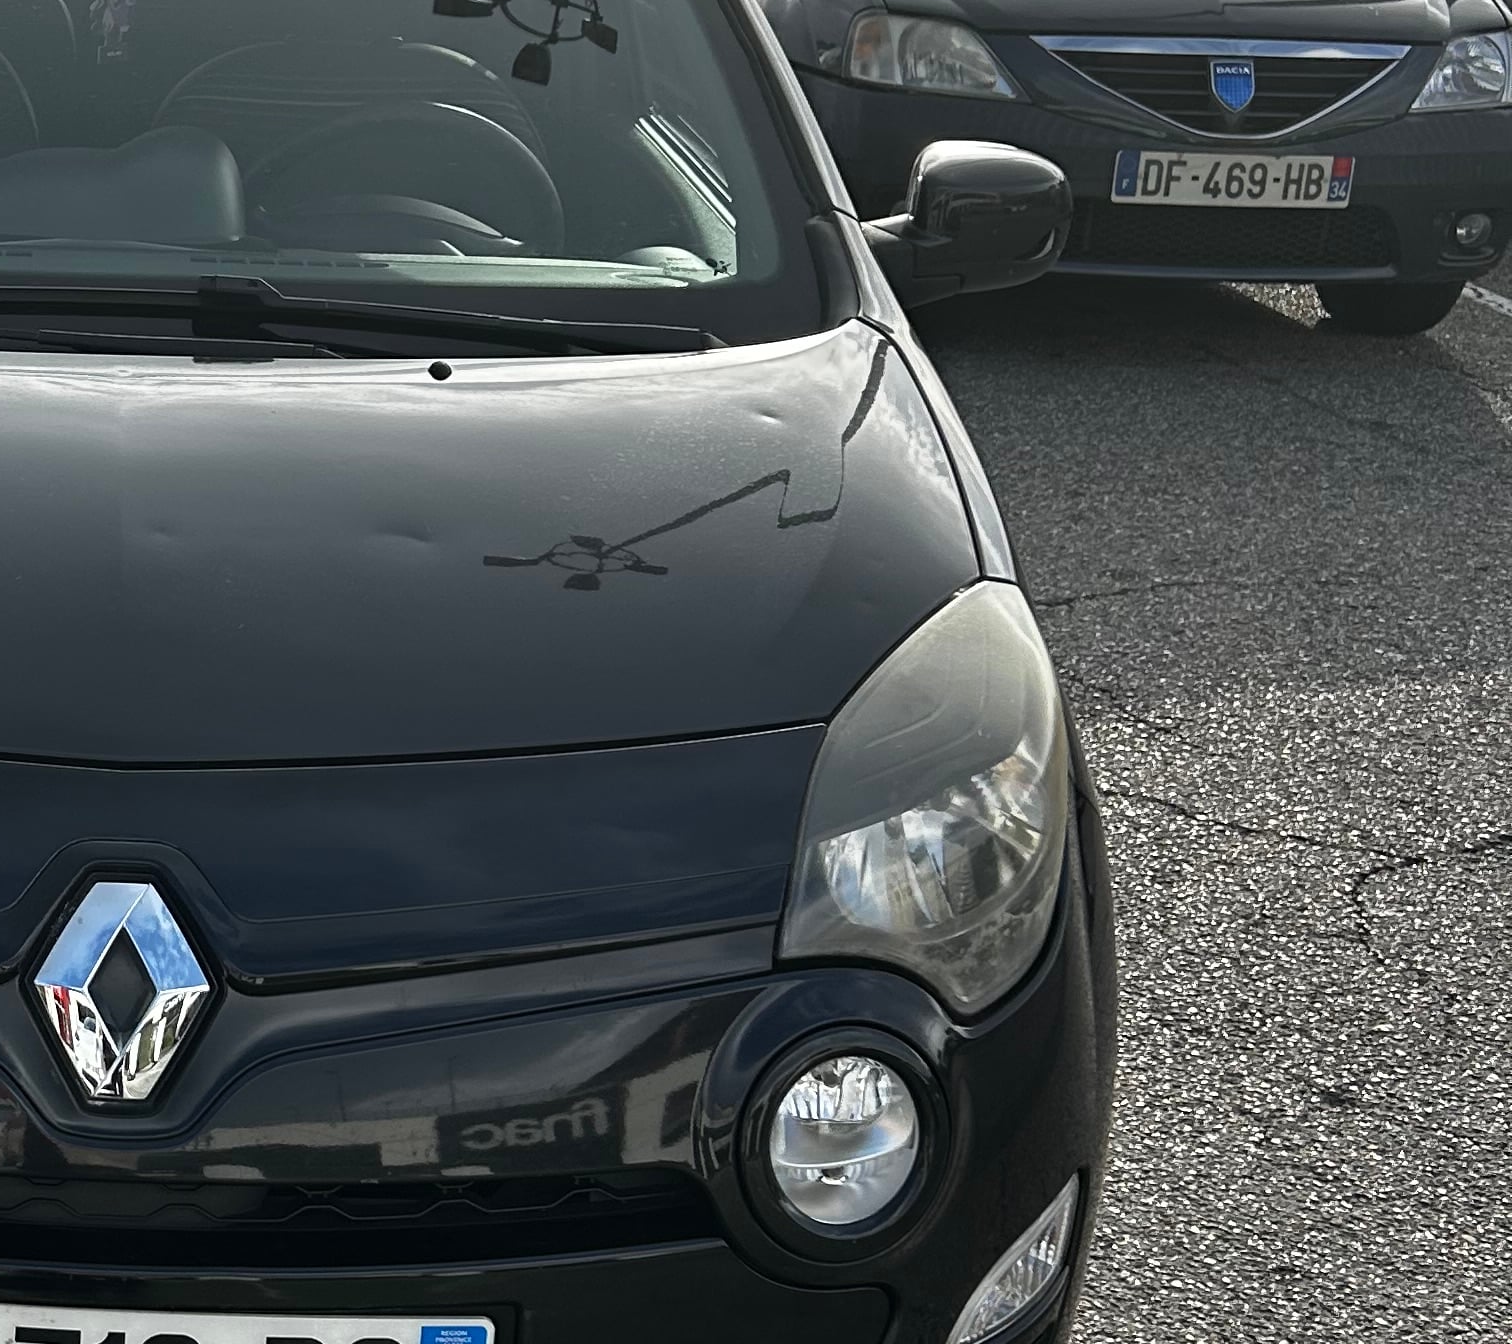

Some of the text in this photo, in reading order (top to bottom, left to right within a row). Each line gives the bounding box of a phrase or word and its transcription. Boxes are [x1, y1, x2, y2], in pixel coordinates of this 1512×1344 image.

[1216, 66, 1250, 75] DACIA
[1121, 178, 1130, 189] F
[1141, 159, 1325, 201] DF-469-HB
[1329, 181, 1346, 199] 34
